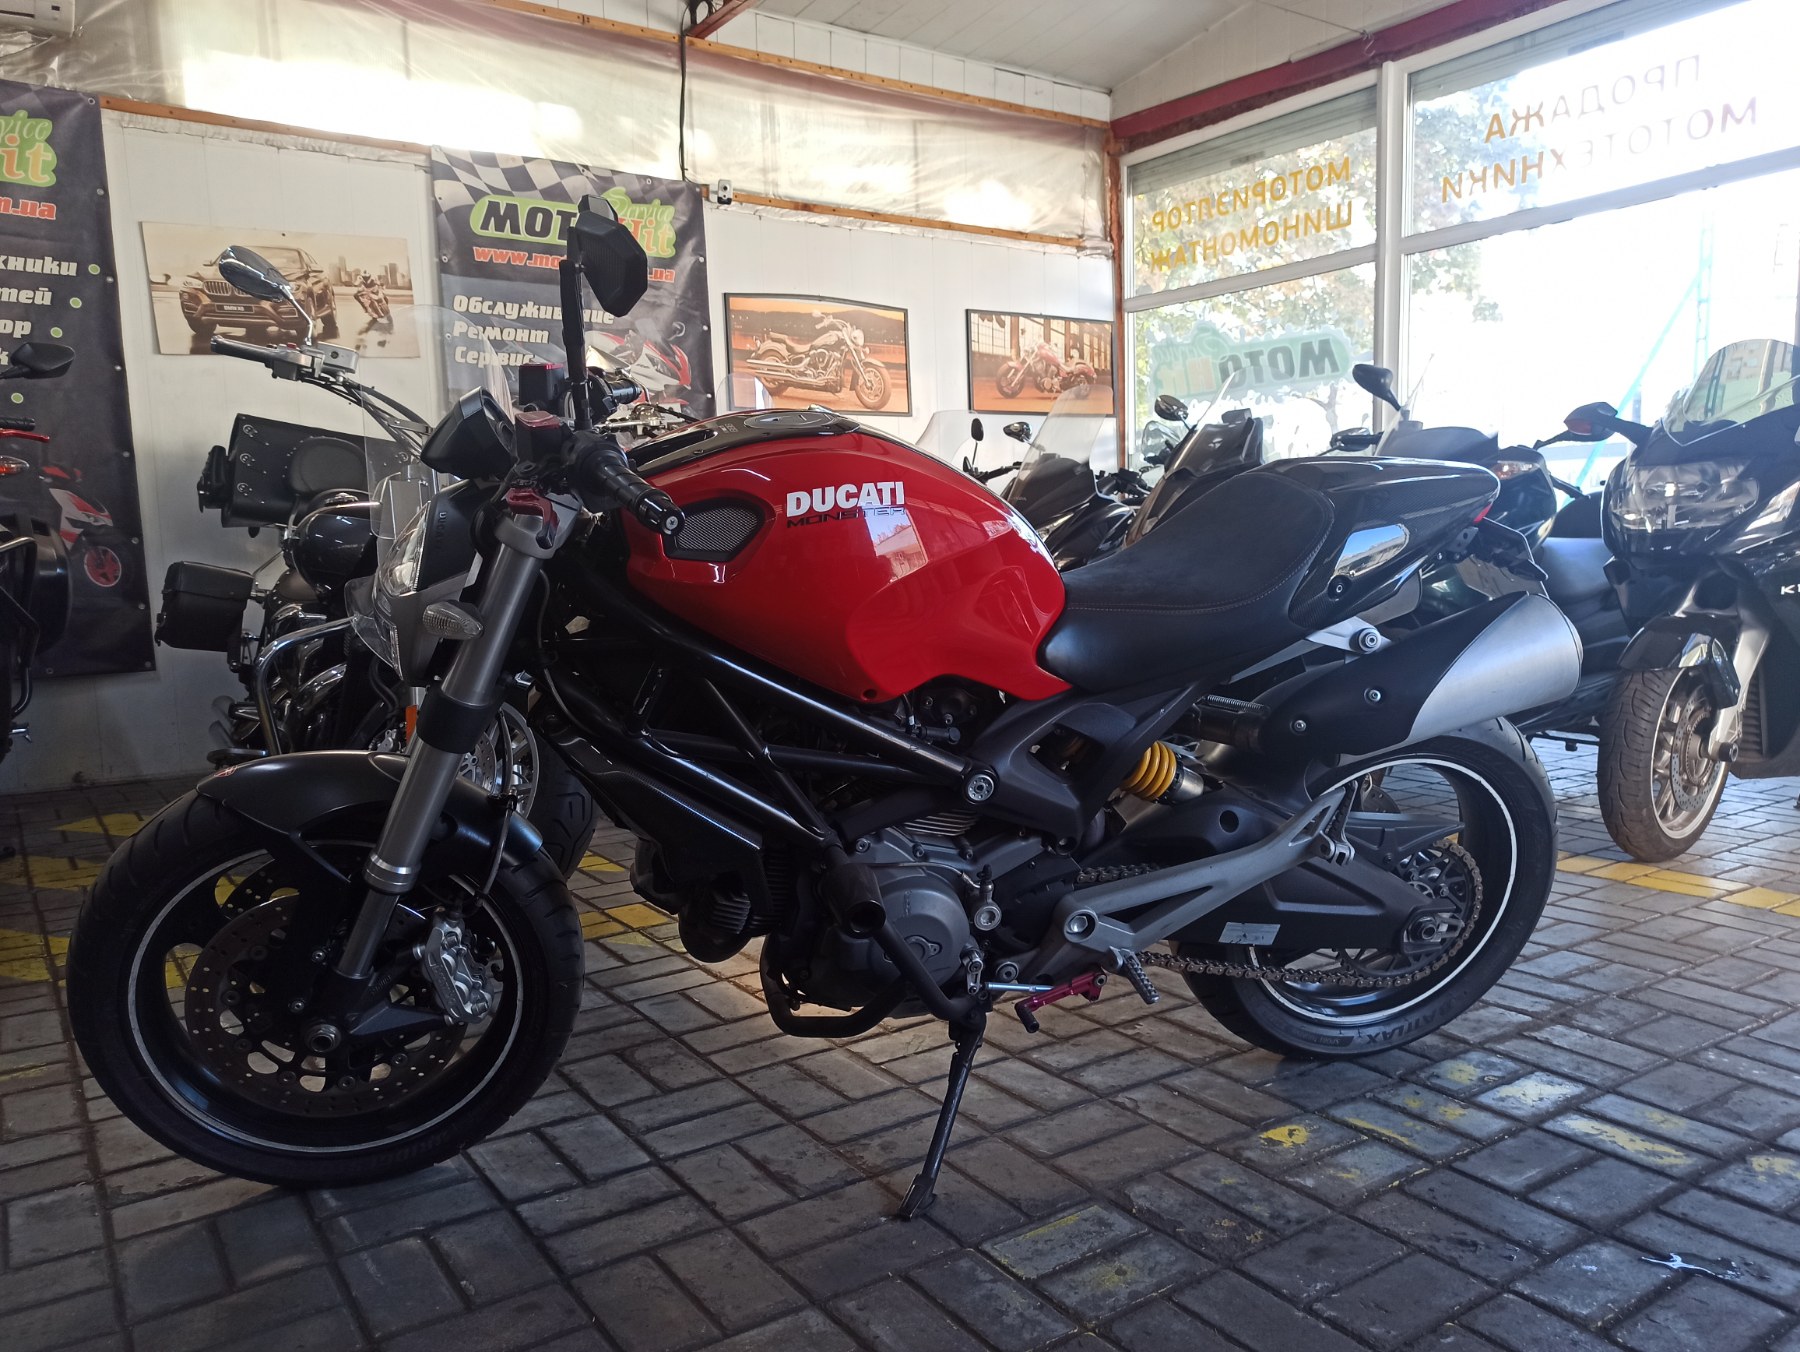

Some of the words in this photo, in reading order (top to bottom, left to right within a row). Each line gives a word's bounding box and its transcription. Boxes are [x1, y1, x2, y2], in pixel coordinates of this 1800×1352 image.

[480, 200, 578, 240] MOT
[453, 295, 615, 325] Обслуживние
[453, 320, 550, 344] Ремонт
[455, 346, 535, 369] Сервис
[787, 481, 905, 518] DUCATI
[786, 507, 906, 528] MONSTER
